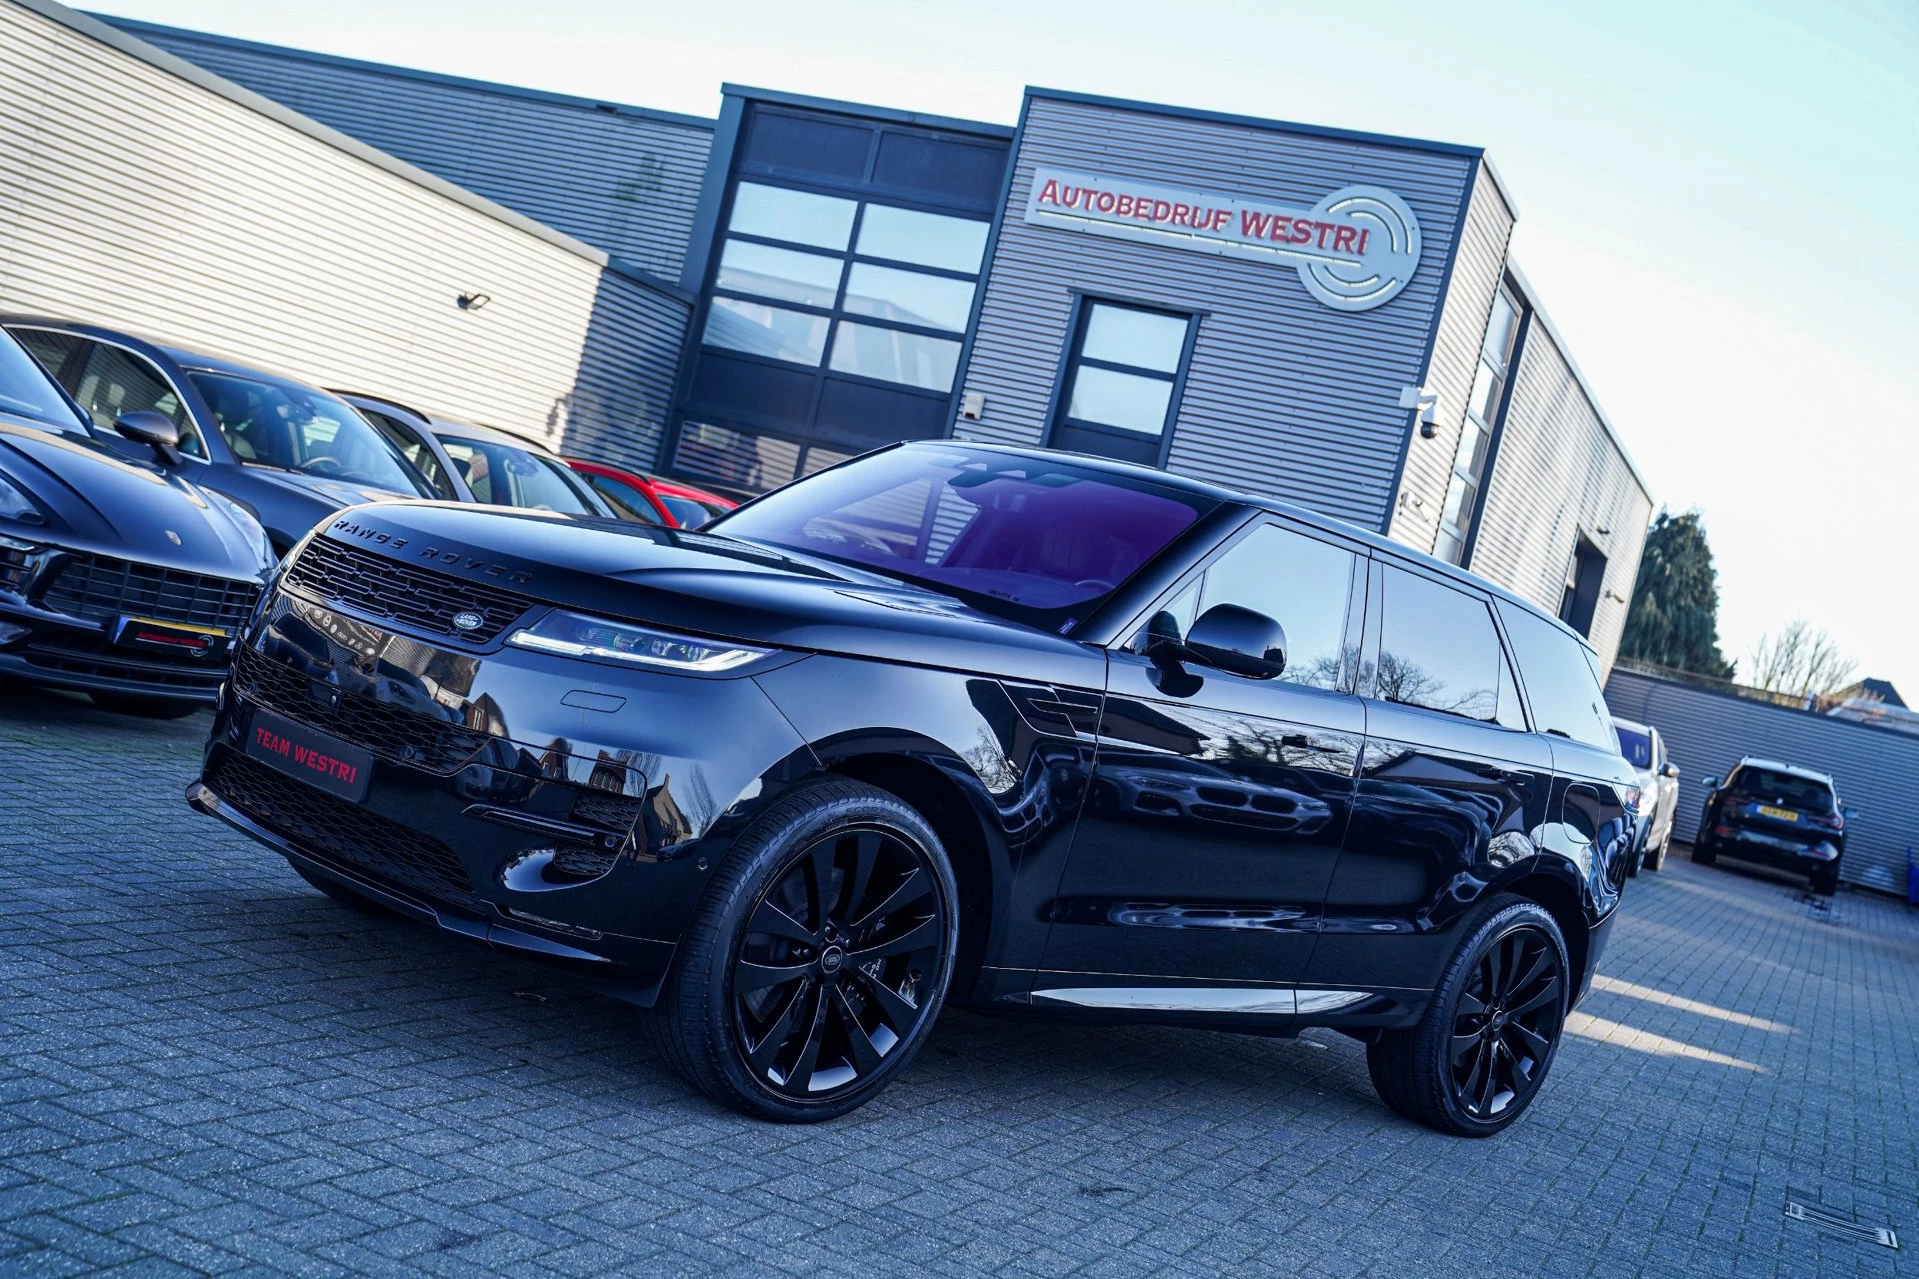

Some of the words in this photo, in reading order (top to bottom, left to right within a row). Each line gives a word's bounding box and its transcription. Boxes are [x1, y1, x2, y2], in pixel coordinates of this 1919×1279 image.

[1038, 179, 1233, 232] AUTOBEDRIJF
[1241, 209, 1370, 256] WESTRI
[334, 520, 409, 549] RANGE
[419, 547, 533, 584] ROVER
[256, 727, 291, 758] TEAM
[294, 744, 358, 784] WESTRI
